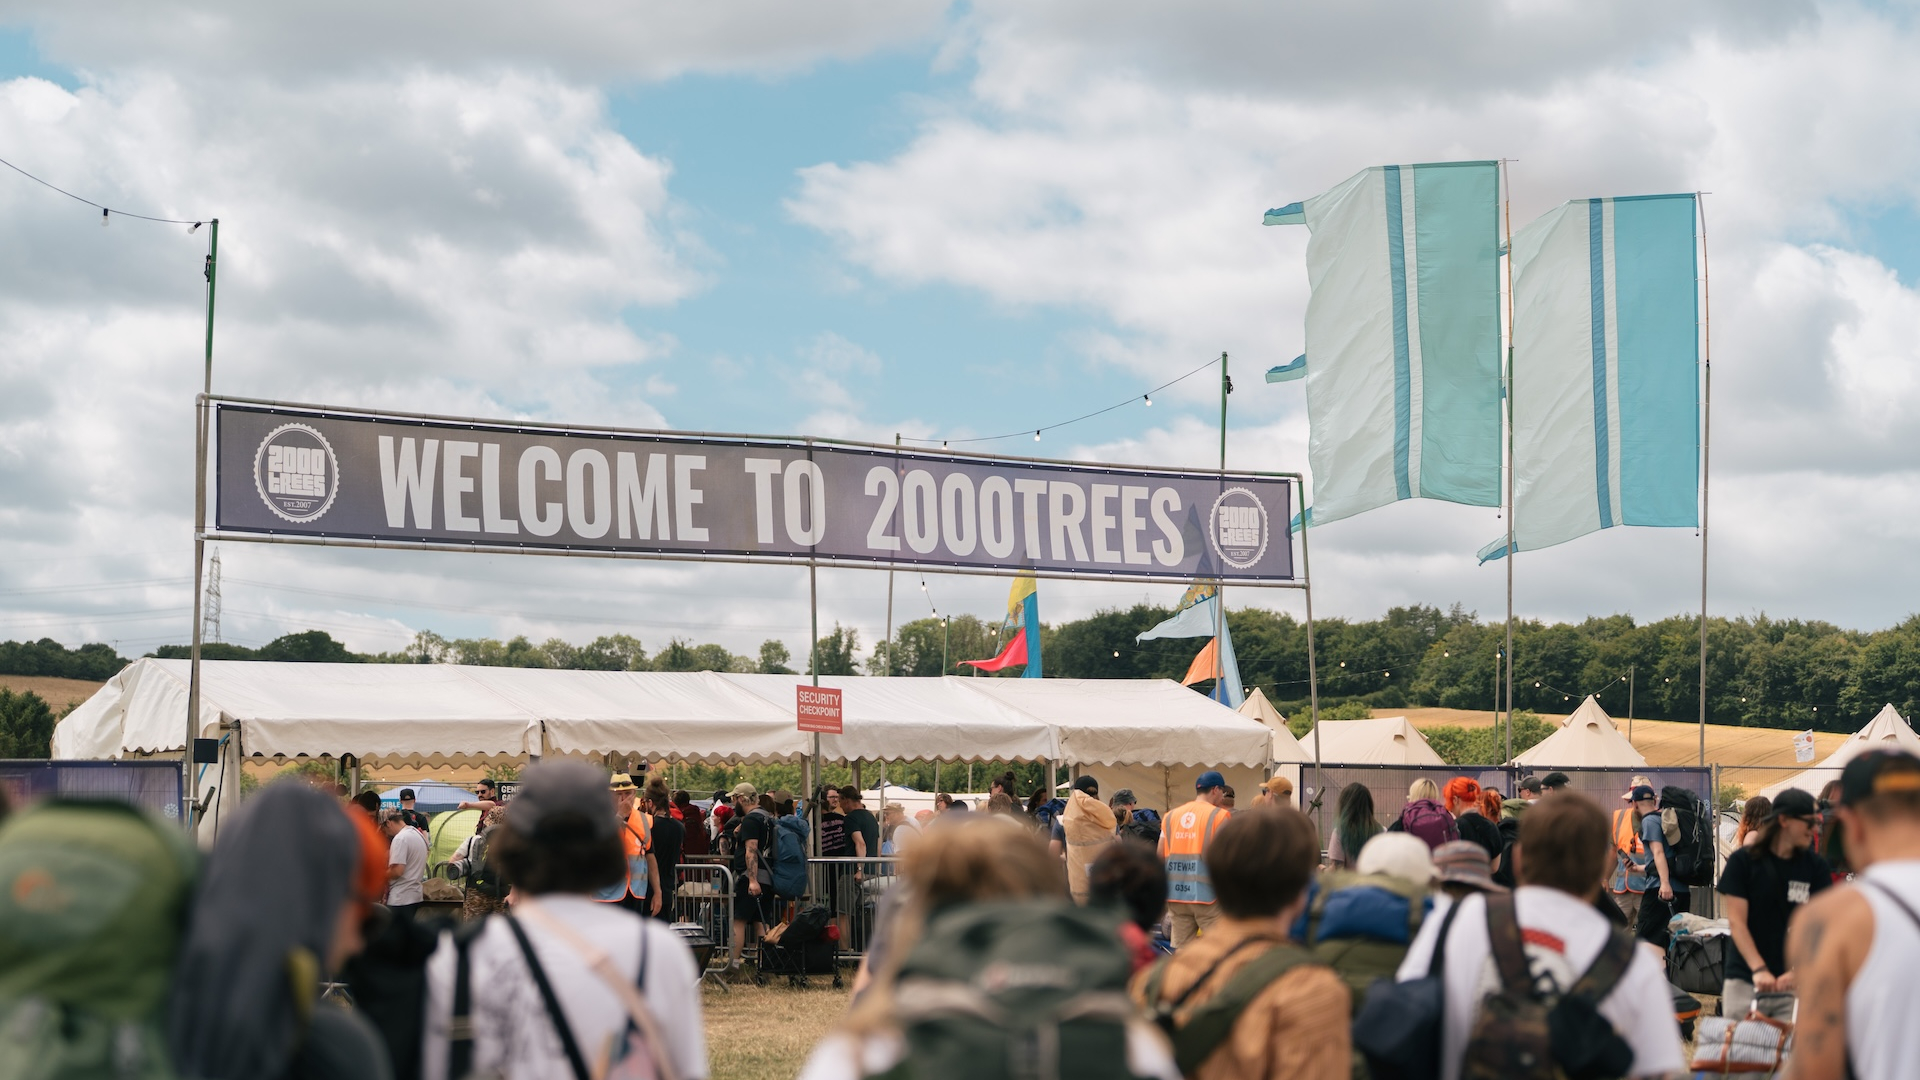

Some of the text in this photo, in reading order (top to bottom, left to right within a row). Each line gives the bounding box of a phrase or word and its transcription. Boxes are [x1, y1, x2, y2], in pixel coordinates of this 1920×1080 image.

[268, 445, 325, 476] 2000
[283, 501, 312, 509] EST.2007
[378, 435, 1185, 567] WELCOME TO 2000TREES
[1219, 505, 1260, 529] 2000
[799, 691, 840, 706] SECURITY
[799, 704, 840, 717] CHECKPOINT
